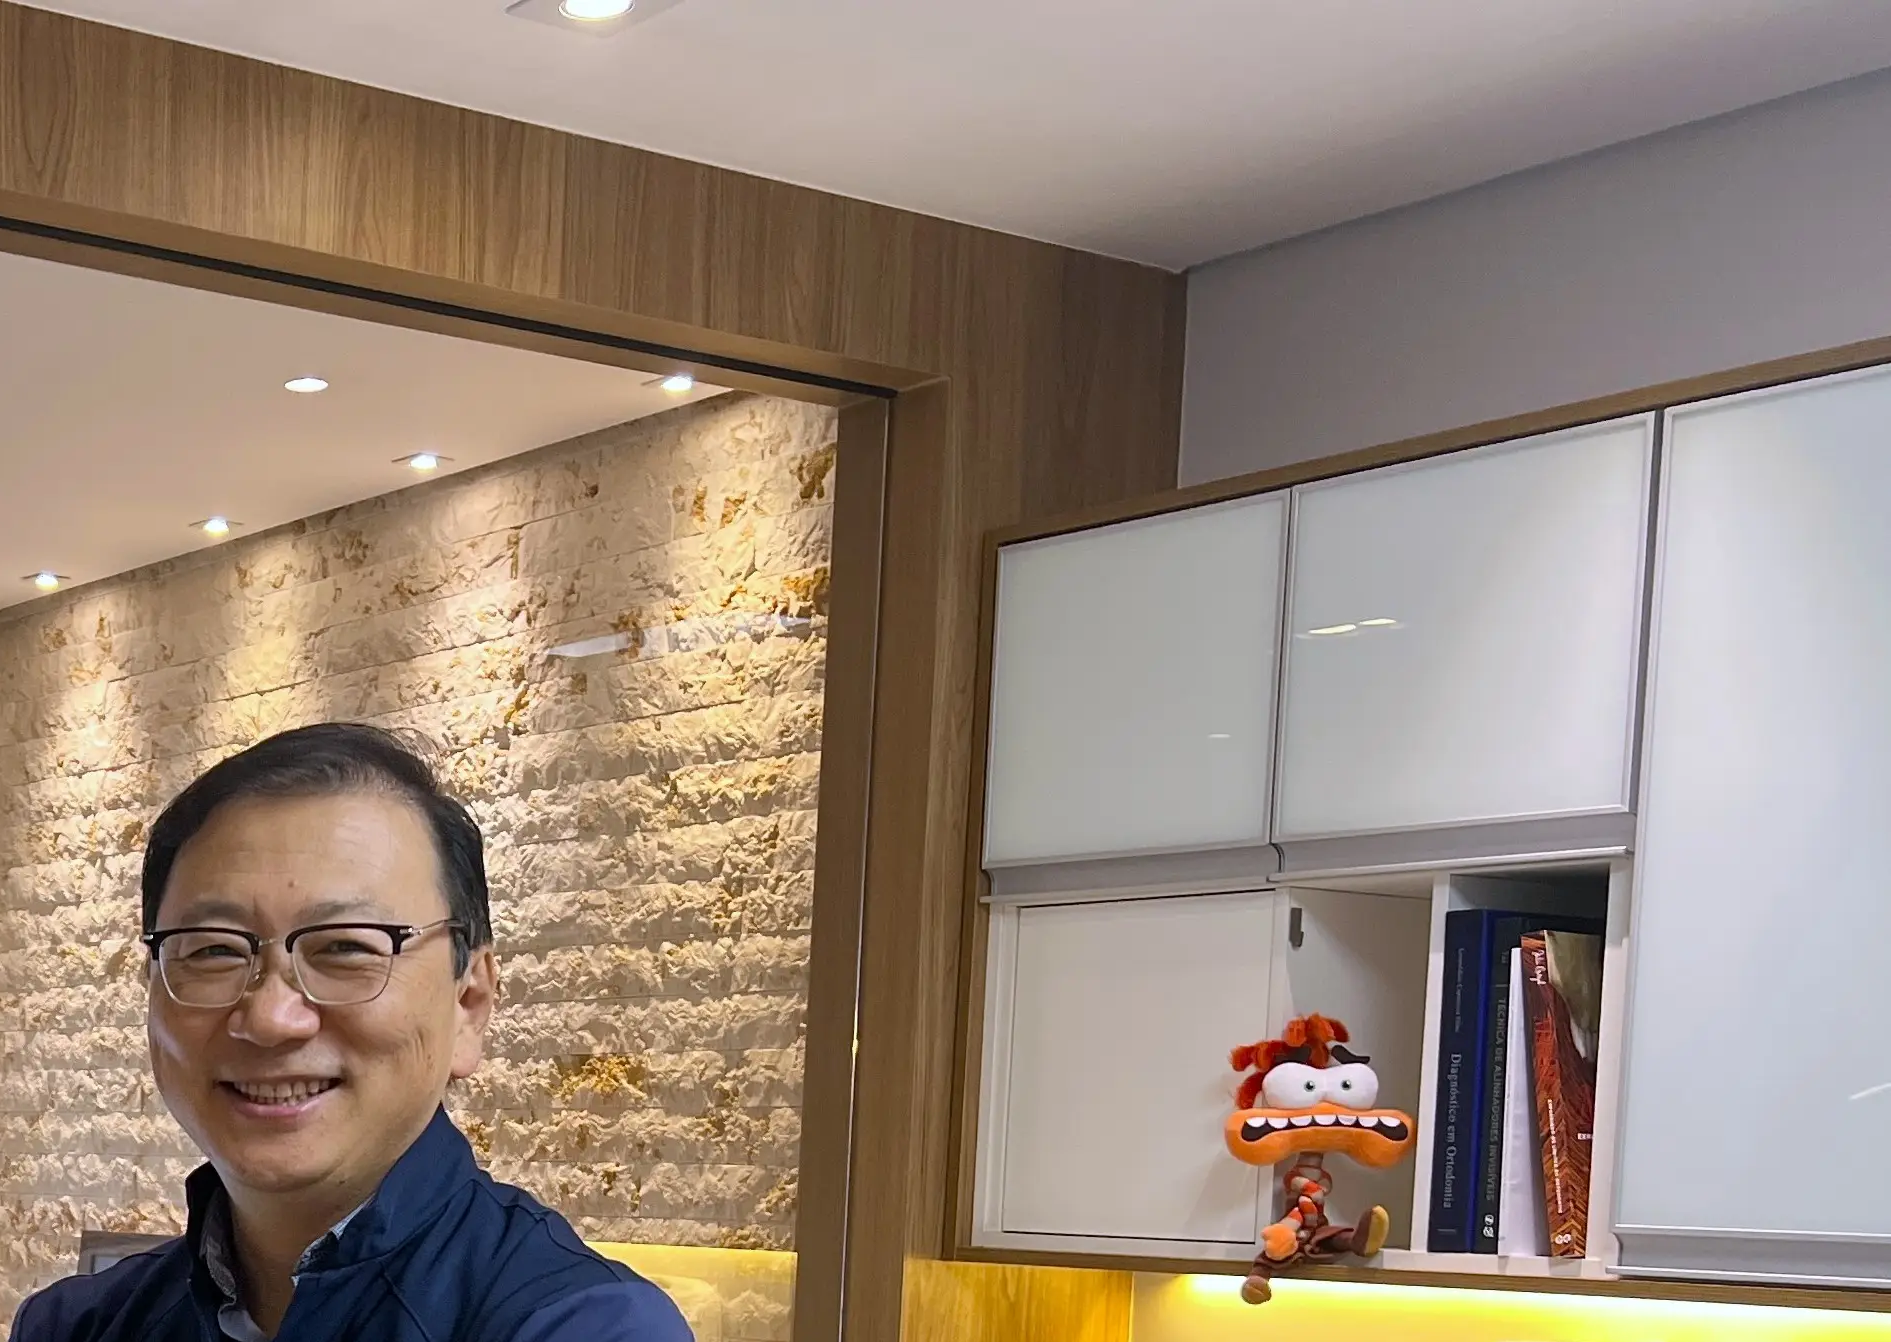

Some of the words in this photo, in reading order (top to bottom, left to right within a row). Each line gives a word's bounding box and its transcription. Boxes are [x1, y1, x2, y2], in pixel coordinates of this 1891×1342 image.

[1447, 1054, 1462, 1123] Diagnóstico
[1490, 1065, 1502, 1142] ALINHADORES
[1447, 1126, 1456, 1142] em
[1443, 1145, 1457, 1208] Ortodontia
